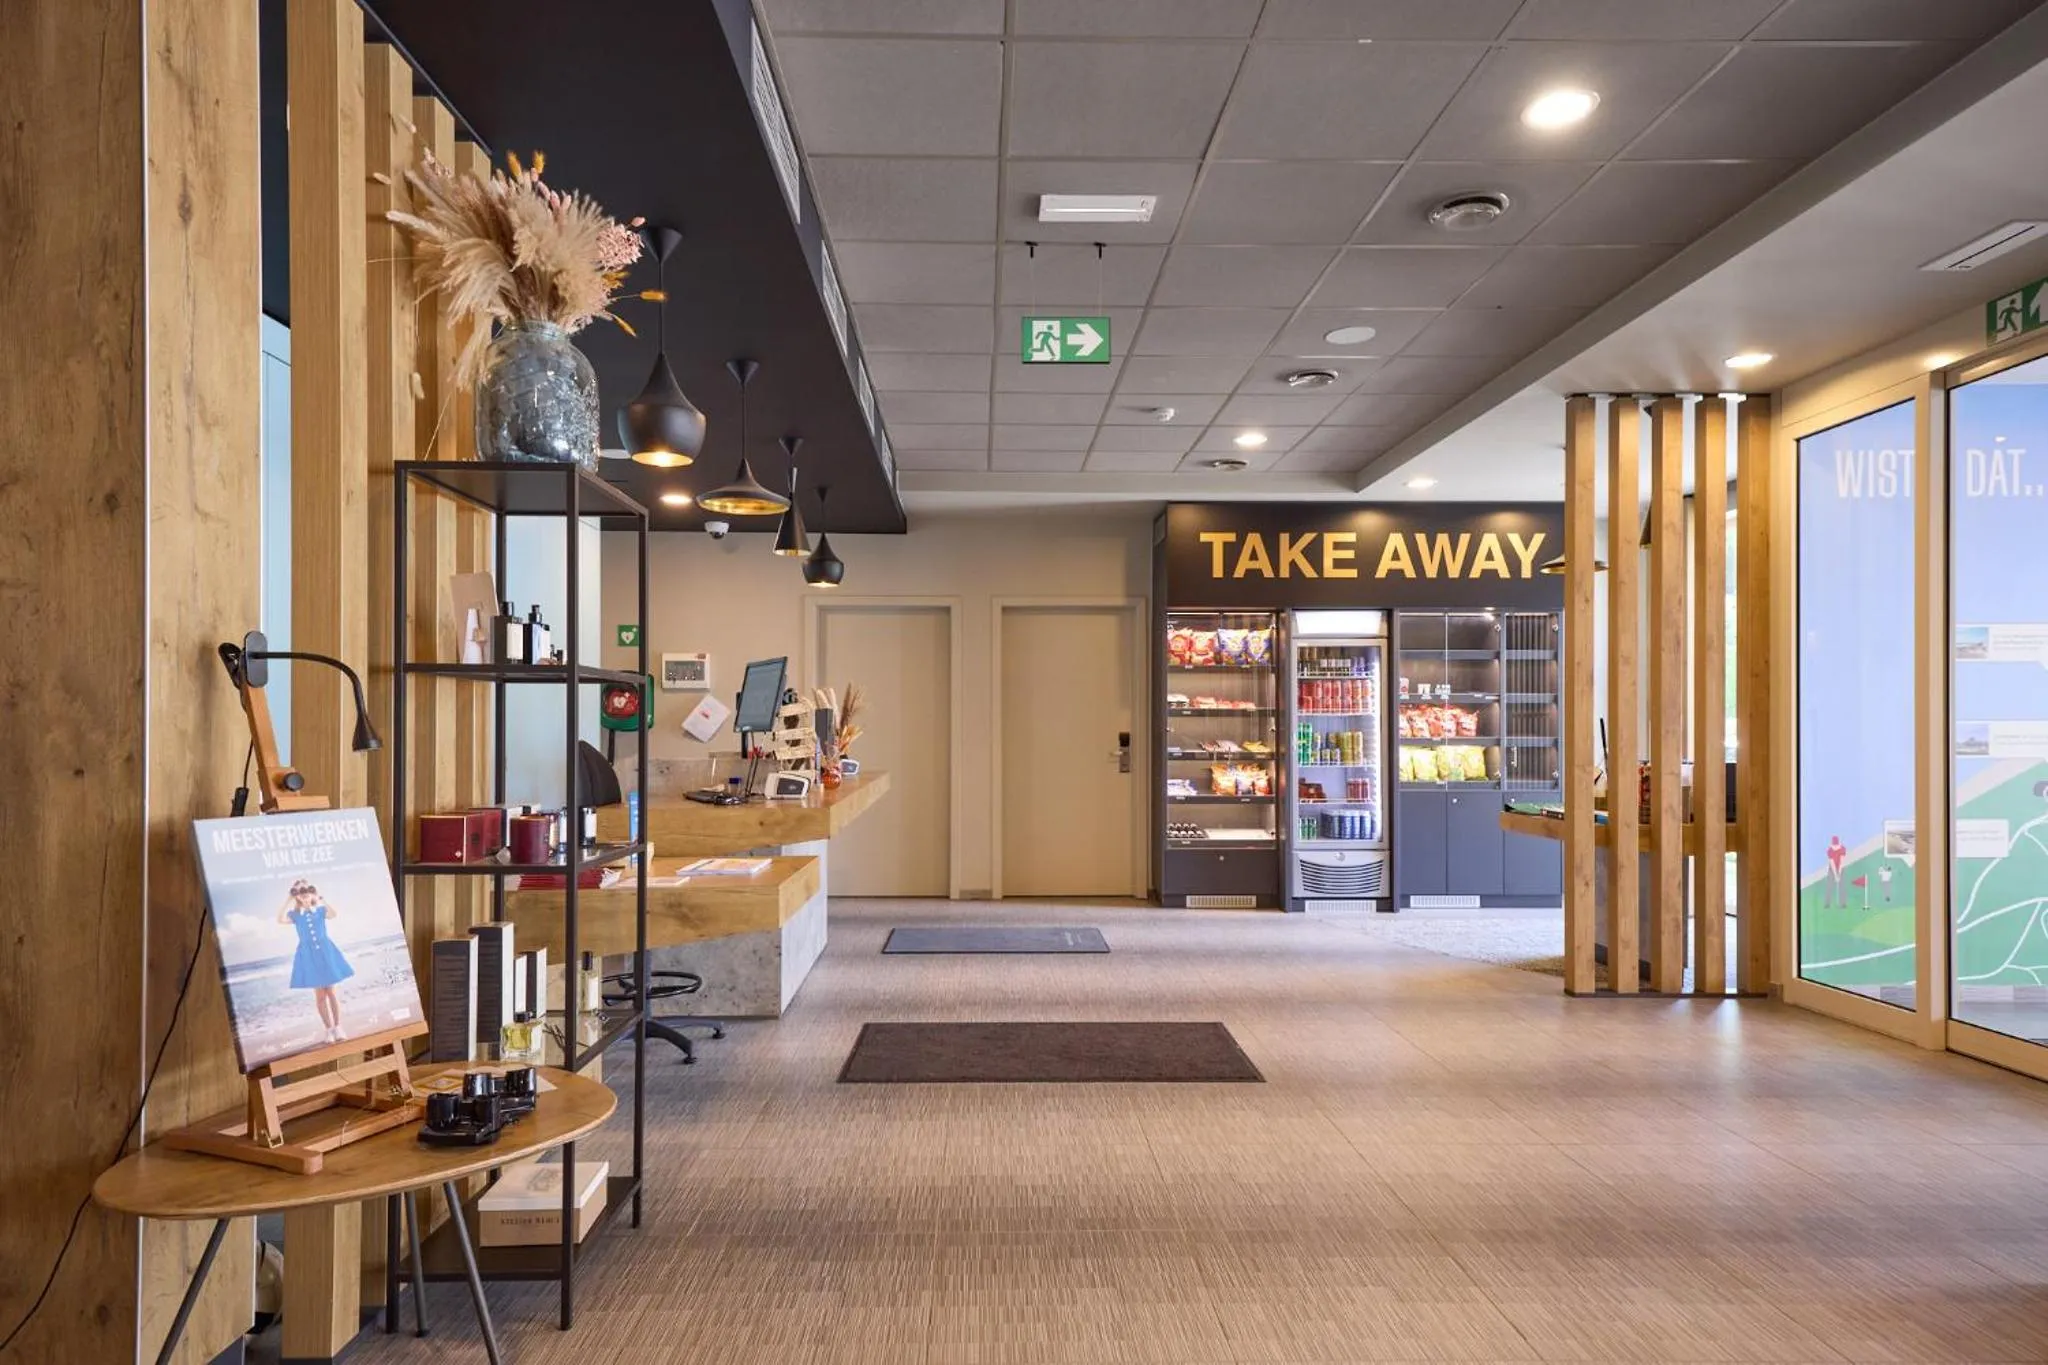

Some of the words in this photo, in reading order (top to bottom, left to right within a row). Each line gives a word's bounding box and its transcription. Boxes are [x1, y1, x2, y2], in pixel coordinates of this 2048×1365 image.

[1835, 449, 1915, 498] WIST
[1199, 532, 1358, 578] TAKE
[1374, 532, 1546, 578] AWAY
[212, 817, 369, 854] MEESTERWERKEN
[262, 848, 291, 869] VAN
[293, 847, 310, 866] DE
[312, 844, 335, 864] ZEE
